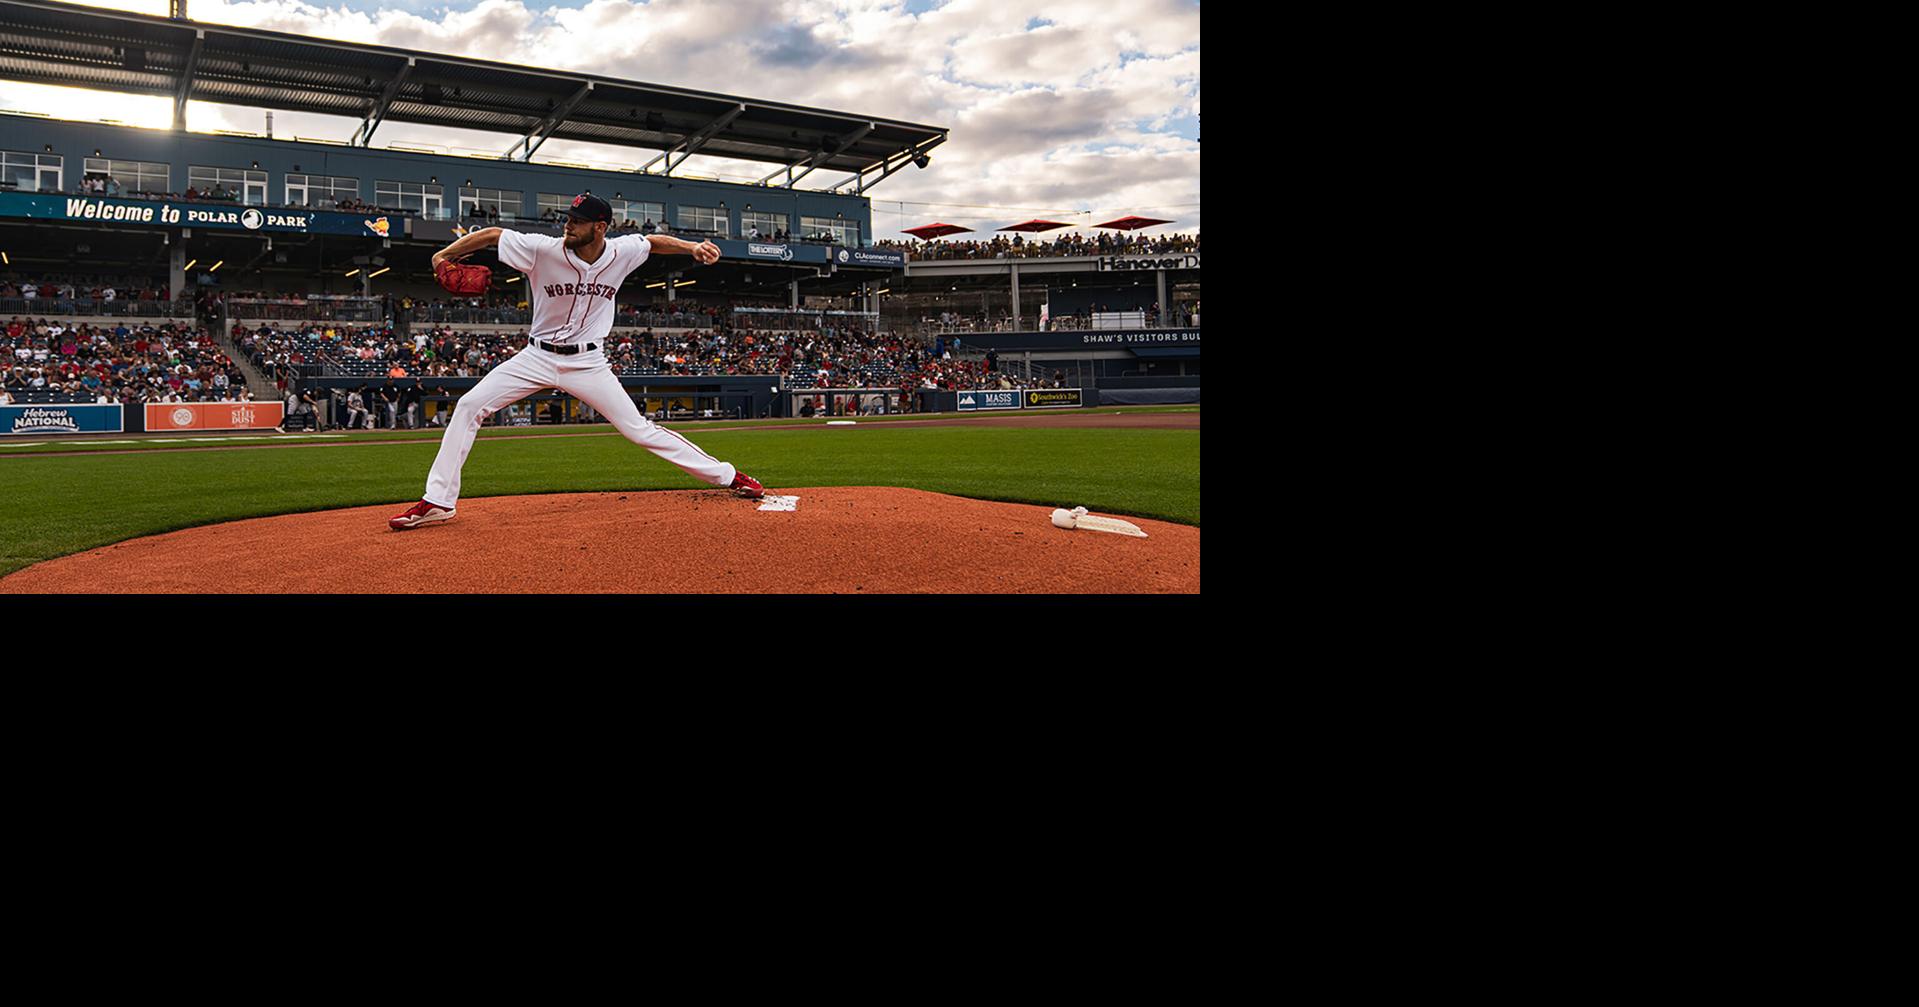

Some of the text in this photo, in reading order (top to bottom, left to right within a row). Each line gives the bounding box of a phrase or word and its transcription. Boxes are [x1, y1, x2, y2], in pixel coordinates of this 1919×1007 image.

[66, 198, 306, 228] Welcome to POLAR PARK
[854, 252, 901, 262] CLAconnect.com
[1099, 256, 1183, 271] Hanover
[1083, 334, 1123, 343] SHAW'S
[1127, 333, 1178, 342] VISITORS
[985, 393, 1012, 403] MASIS
[23, 408, 68, 418] Hebrew
[14, 417, 76, 428] NATIONAL
